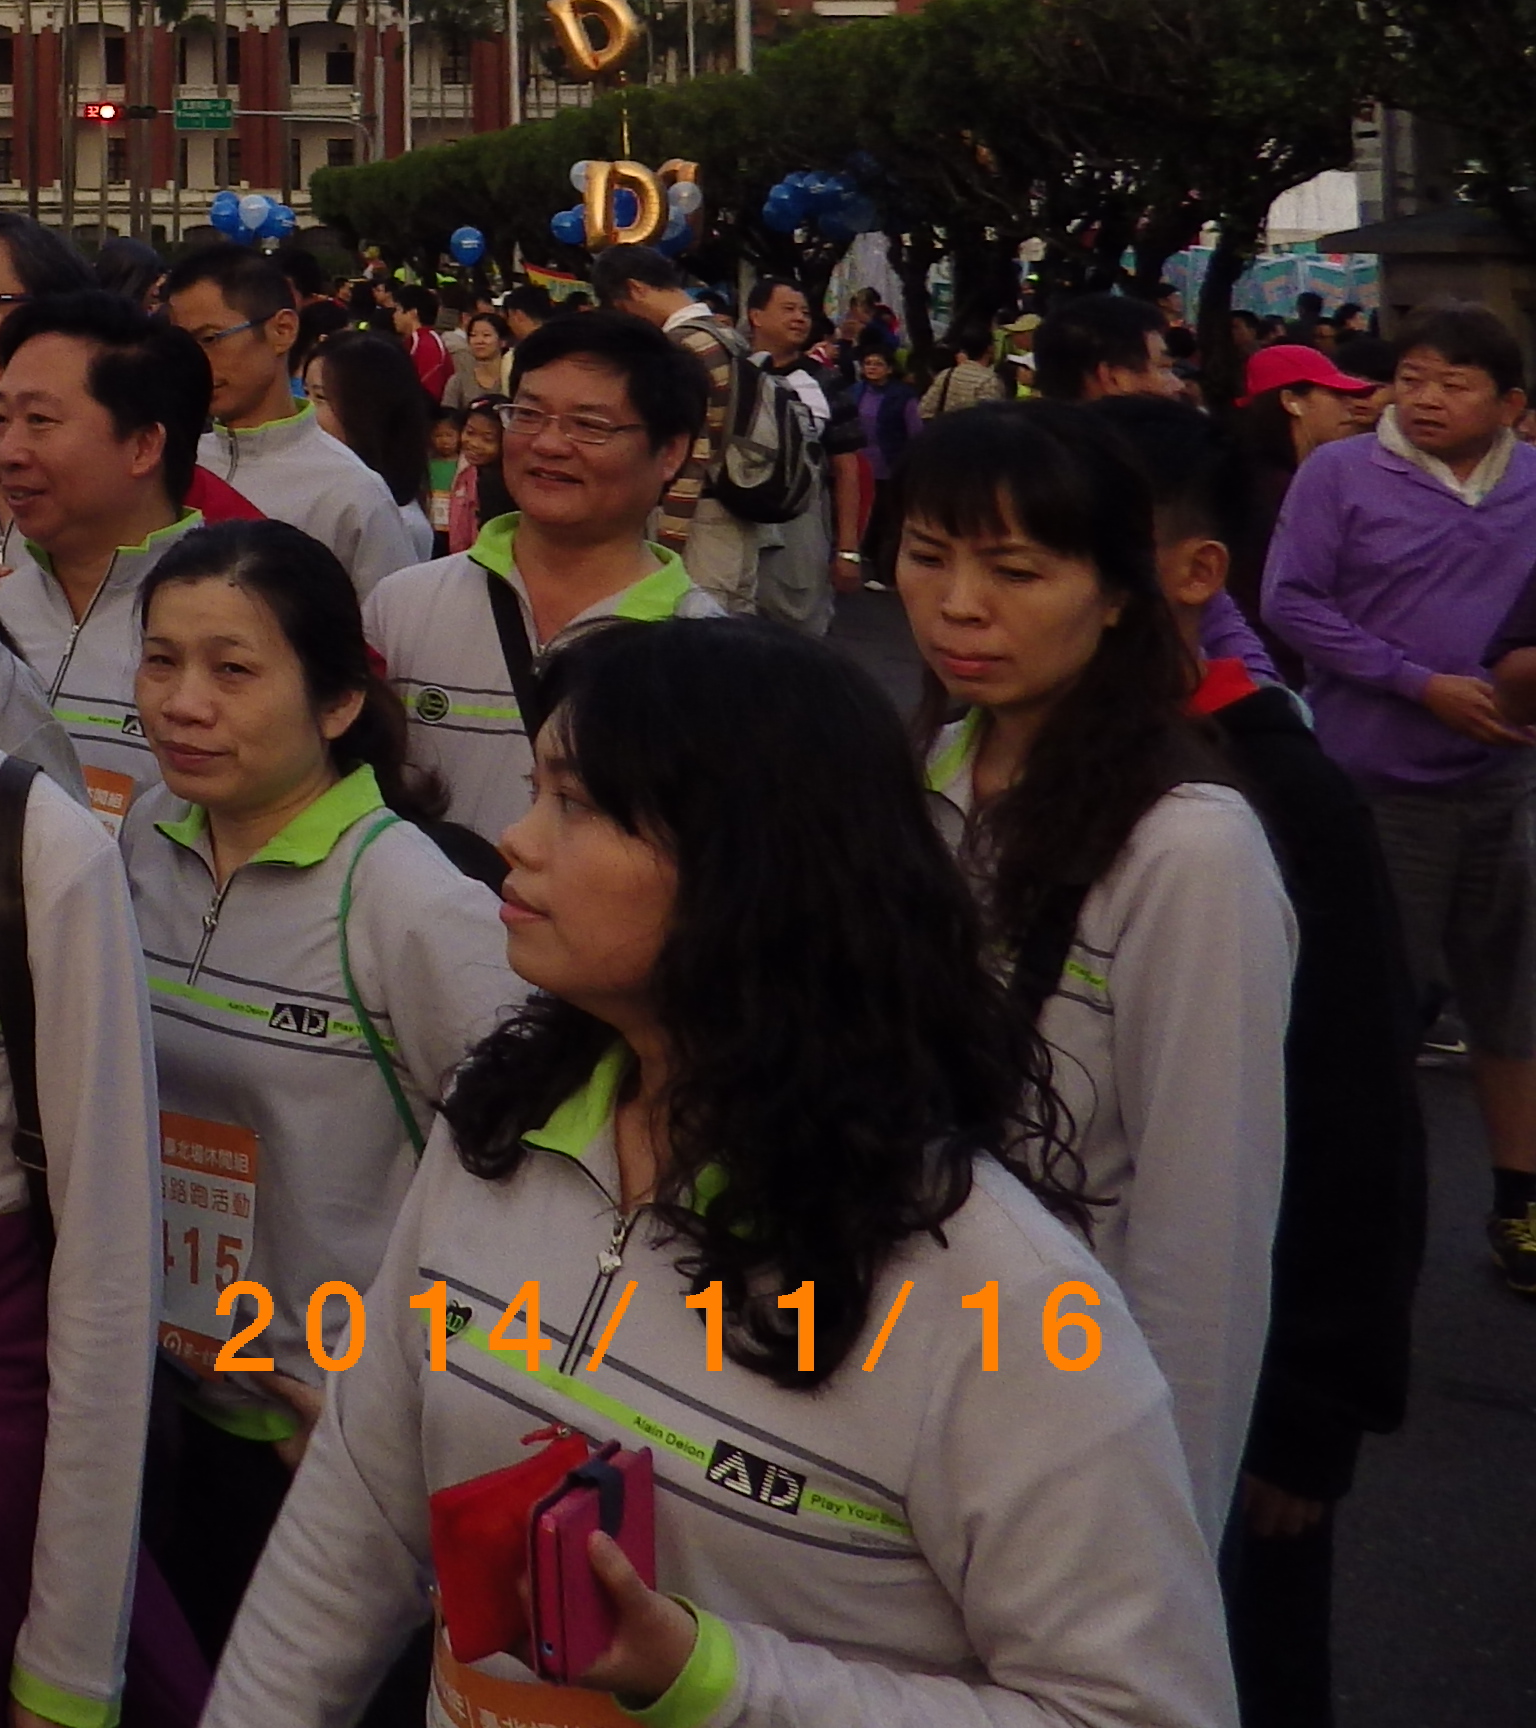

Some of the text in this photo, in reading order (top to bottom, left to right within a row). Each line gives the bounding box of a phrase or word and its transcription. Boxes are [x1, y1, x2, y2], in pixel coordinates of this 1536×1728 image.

[162, 1175, 250, 1219] 路跑活動
[633, 1415, 663, 1439] Alain
[665, 1431, 705, 1460] Delon
[810, 1493, 844, 1516] Play
